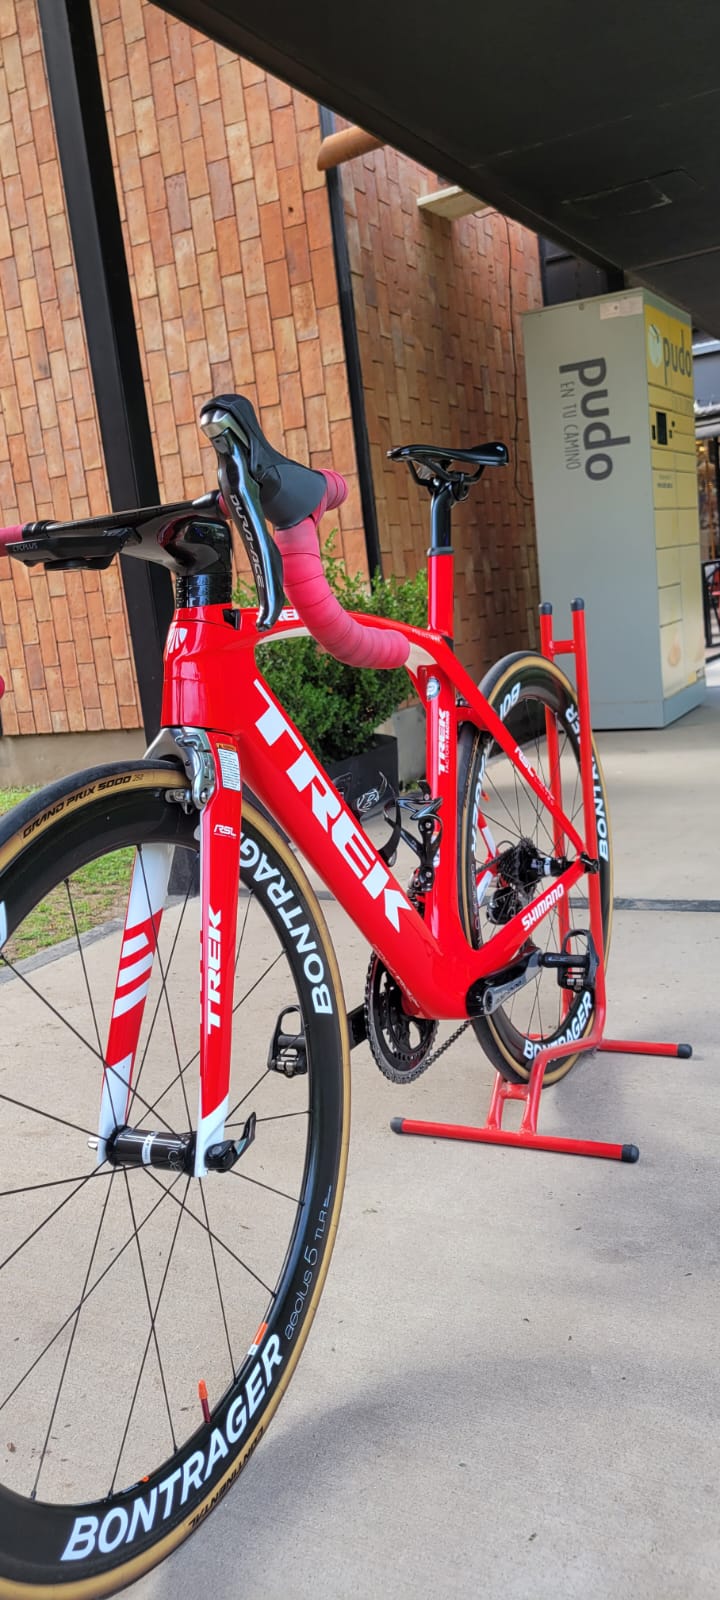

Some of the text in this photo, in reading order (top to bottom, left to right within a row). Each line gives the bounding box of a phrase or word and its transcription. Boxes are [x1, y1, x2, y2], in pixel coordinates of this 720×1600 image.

[663, 330, 692, 385] pudo
[559, 357, 631, 481] pudo
[560, 381, 582, 470] EN TU CAMINO
[229, 494, 265, 589] DURA-ACE
[23, 801, 64, 839] GRAND
[67, 786, 95, 809] PRIX
[99, 774, 132, 790] 5000
[214, 824, 237, 837] RSL
[255, 678, 412, 933] TREK
[239, 831, 334, 1016] BONTRAG
[522, 883, 565, 932] SHIMANO
[205, 904, 223, 1035] TREK
[285, 1271, 313, 1341] aeolus
[304, 1247, 318, 1266] 5
[314, 1208, 328, 1245] TLR
[61, 1333, 283, 1562] BONTRAGER
[189, 1425, 265, 1530] CONTINENTAL
